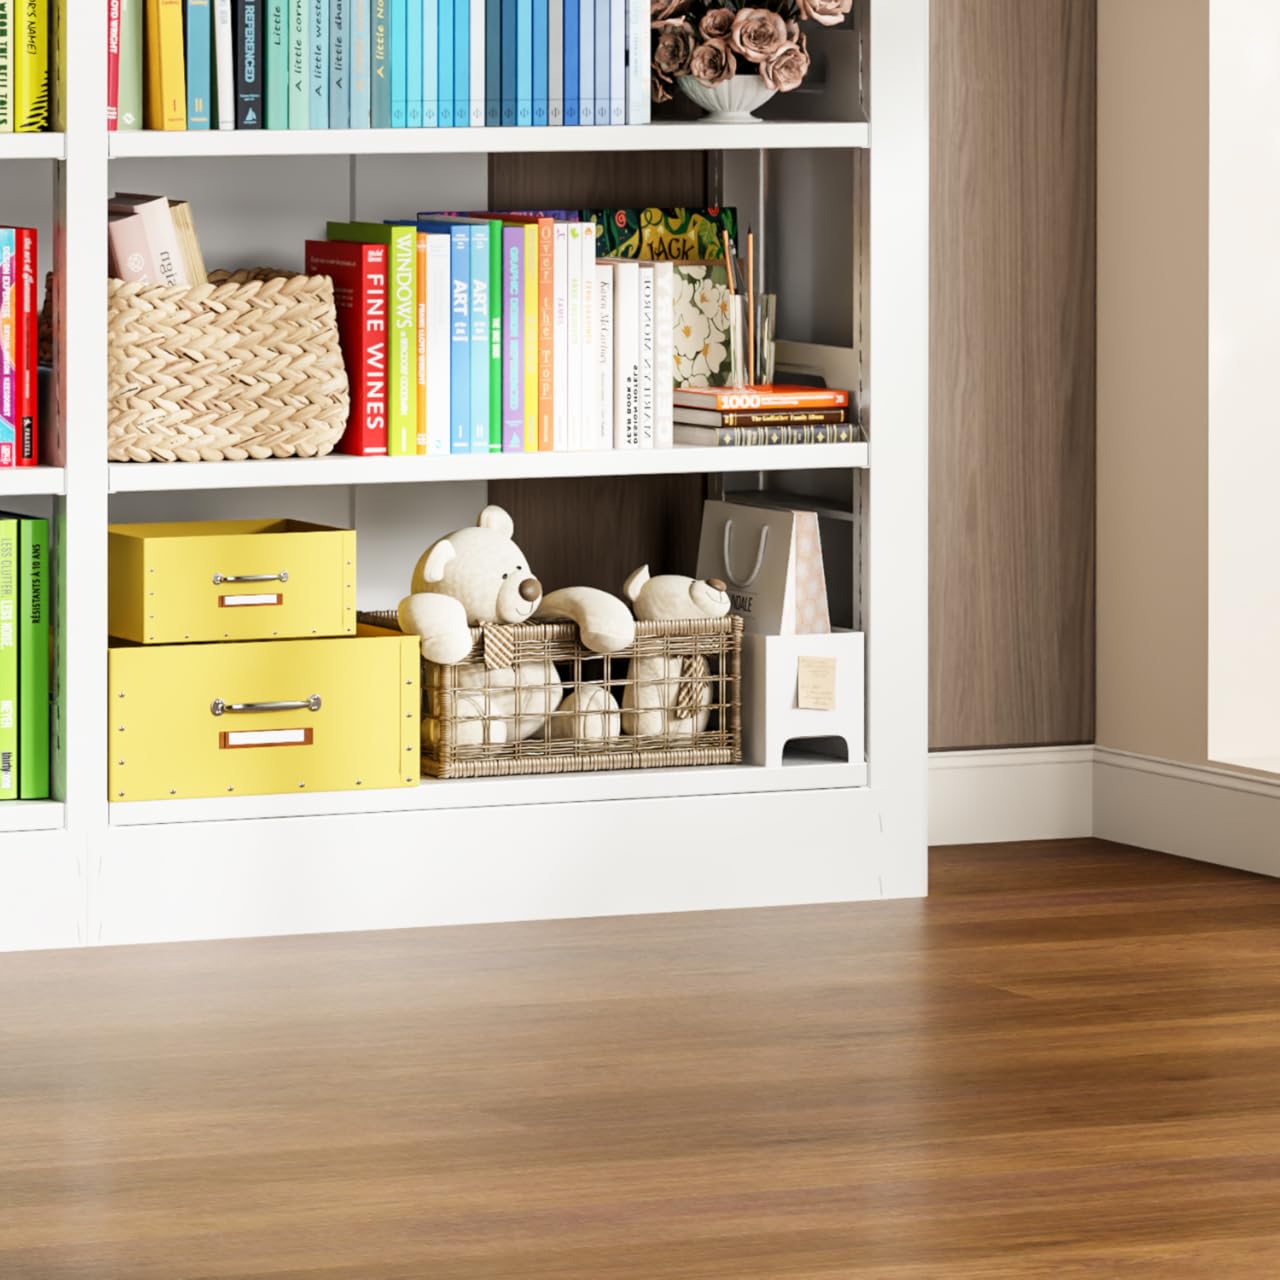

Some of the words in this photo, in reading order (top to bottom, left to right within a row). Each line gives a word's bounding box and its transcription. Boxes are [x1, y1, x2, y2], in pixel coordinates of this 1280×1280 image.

[244, 4, 255, 83] REFERENCED
[335, 36, 343, 71] little
[376, 25, 385, 61] little
[314, 46, 322, 79] little
[376, 65, 385, 79] A
[295, 82, 302, 92] A
[314, 86, 322, 96] A
[335, 78, 343, 89] A
[649, 237, 695, 261] JACK
[396, 233, 412, 329] WINDOWS
[472, 279, 488, 316] ART
[366, 273, 384, 332] FINE
[453, 279, 469, 317] ART
[366, 343, 384, 430] WINES
[721, 395, 761, 409] 1000
[1, 538, 12, 558] LESS
[30, 544, 41, 560] ANS
[1, 560, 12, 597] CLUTTER.
[30, 561, 41, 569] 10
[1, 600, 12, 621] LESS
[30, 578, 41, 624] RÉSISTANTS
